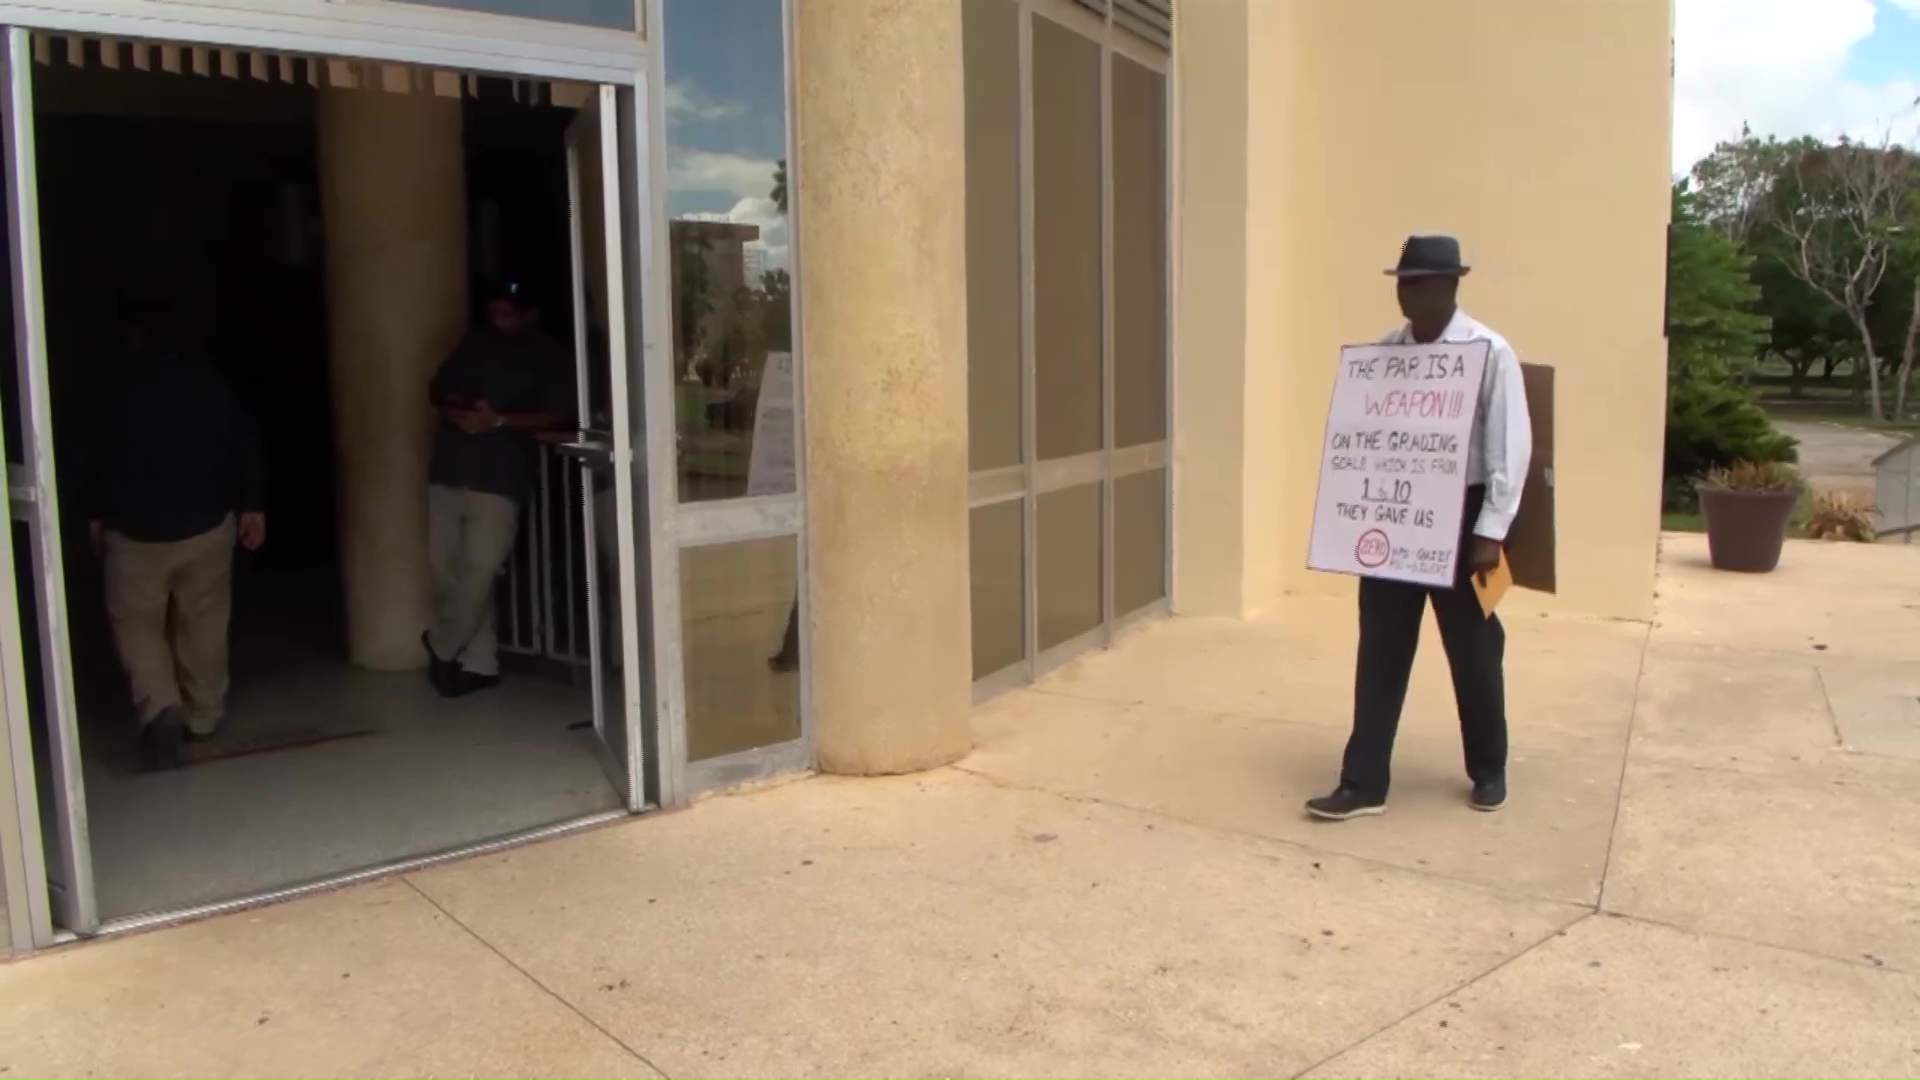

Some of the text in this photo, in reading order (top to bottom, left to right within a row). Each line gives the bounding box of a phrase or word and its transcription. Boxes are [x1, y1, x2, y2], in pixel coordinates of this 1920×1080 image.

[1349, 358, 1380, 380] THE
[1424, 354, 1448, 379] IS
[1452, 355, 1464, 378] A
[1332, 430, 1457, 453] ON THE GRADING
[1410, 458, 1425, 473] IS
[1361, 477, 1369, 499] 1
[1394, 478, 1411, 502] 10
[1336, 503, 1434, 528] THEY GAVE US
[1360, 539, 1386, 555] ZERO
